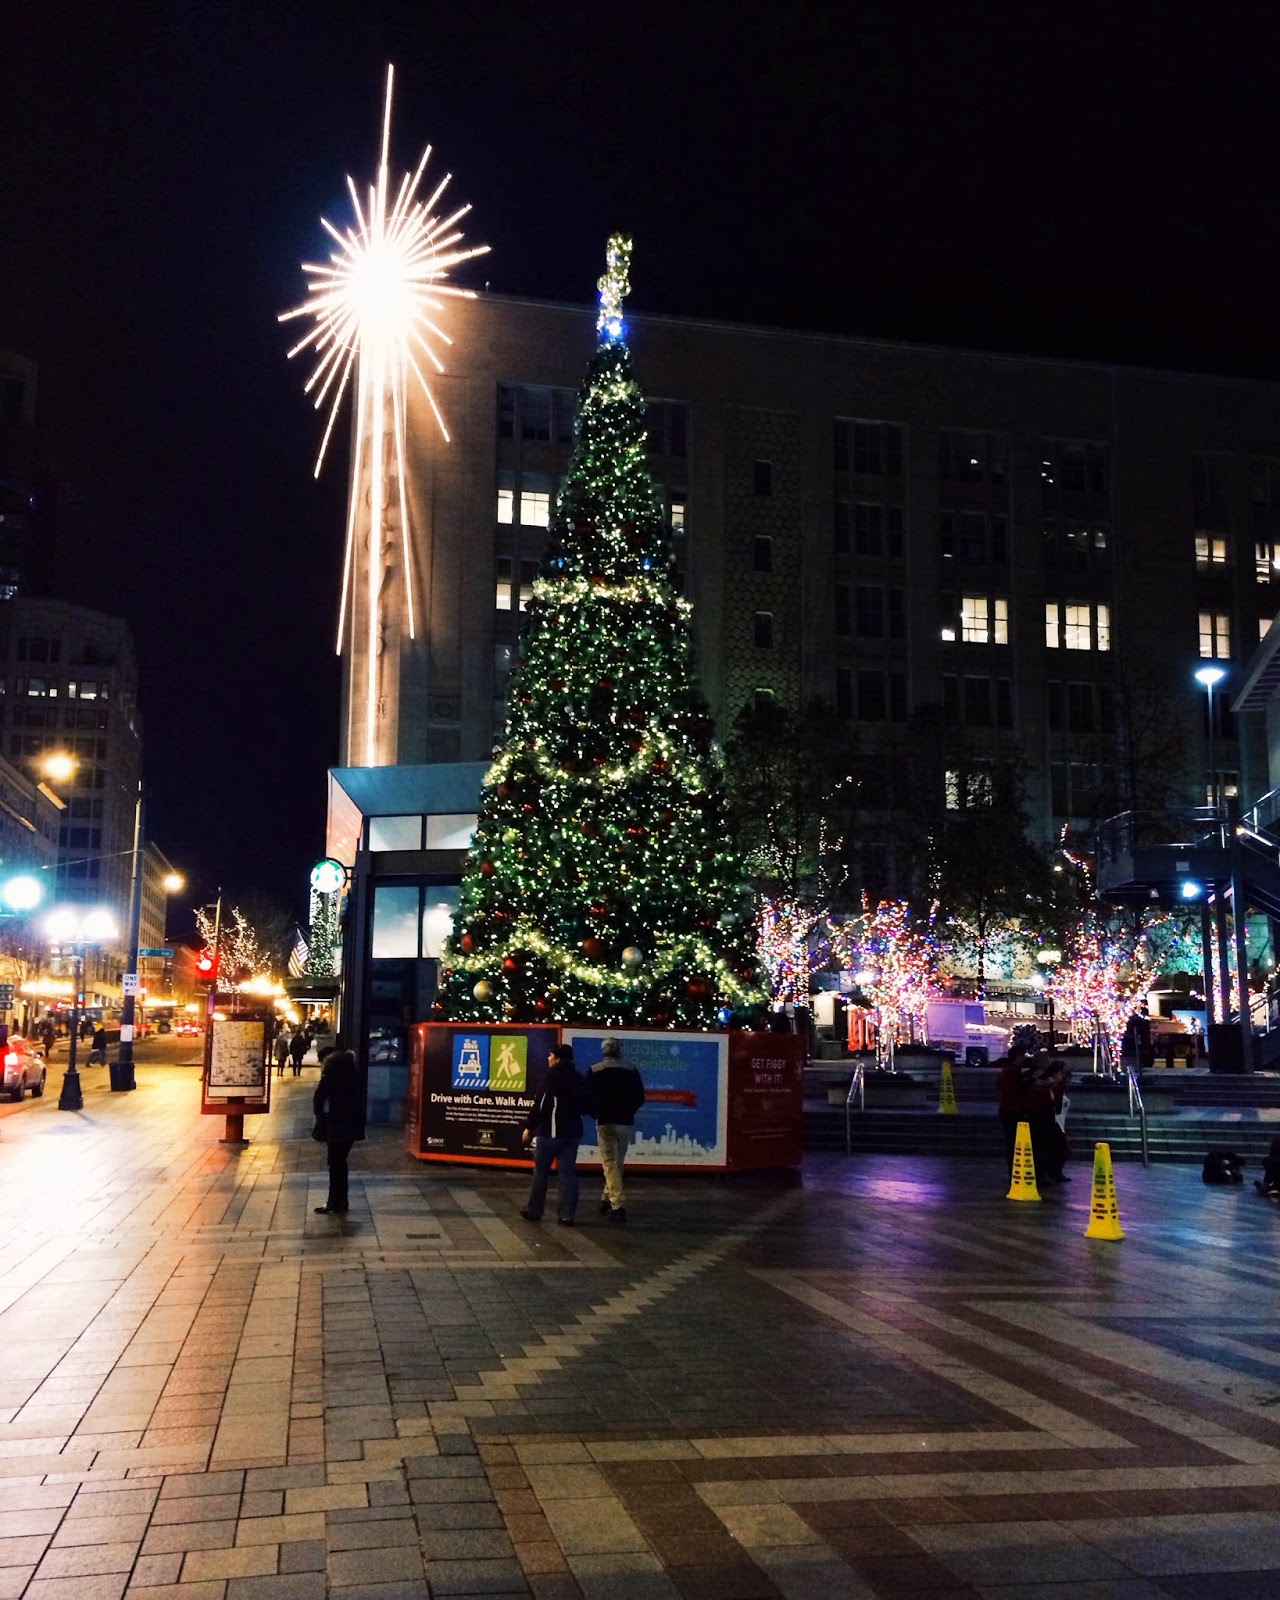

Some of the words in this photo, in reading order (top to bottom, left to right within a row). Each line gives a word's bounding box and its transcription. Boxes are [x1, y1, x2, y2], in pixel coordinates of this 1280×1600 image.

[751, 1058, 765, 1068] GET
[766, 1059, 787, 1069] FIGGY
[755, 1073, 772, 1084] WITH
[430, 1093, 453, 1103] Drive
[453, 1094, 472, 1104] with
[473, 1095, 494, 1105] Care.
[495, 1096, 516, 1106] Walk
